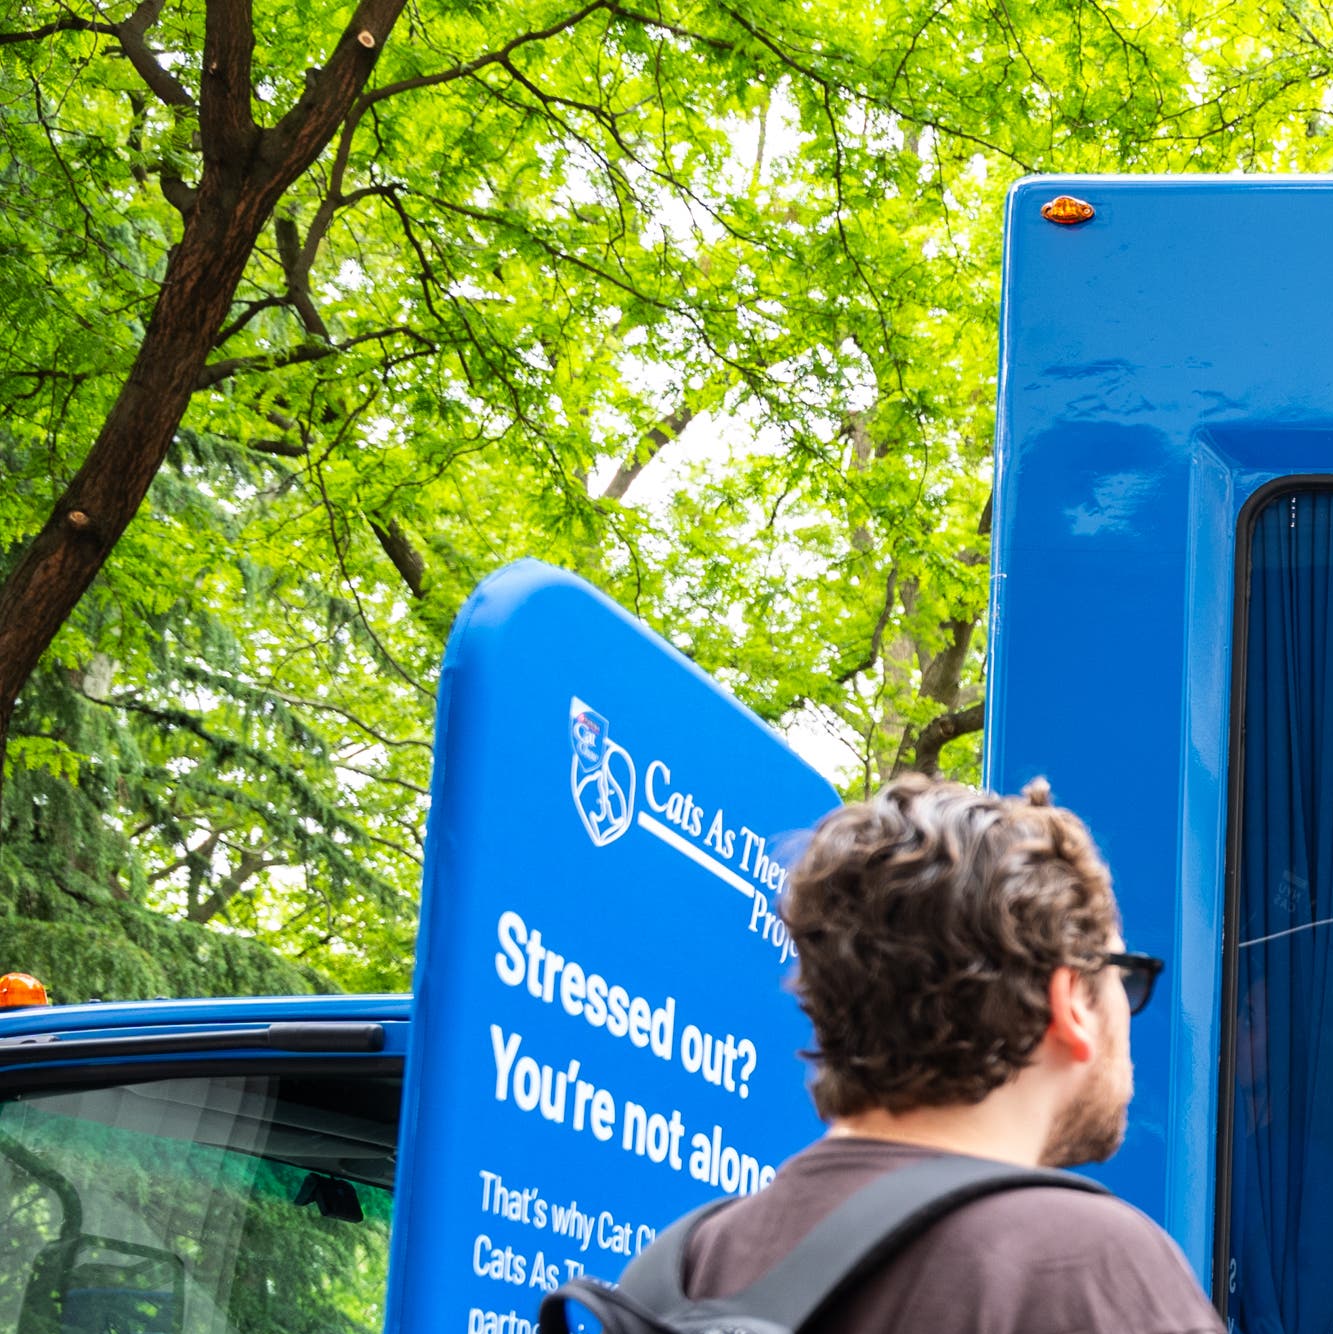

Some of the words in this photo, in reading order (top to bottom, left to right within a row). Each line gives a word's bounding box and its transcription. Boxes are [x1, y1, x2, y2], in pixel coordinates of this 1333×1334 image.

[645, 760, 704, 837] Cats
[703, 808, 736, 859] As
[739, 826, 788, 894] Ther
[495, 910, 676, 1061] Stressed
[680, 1024, 757, 1100] out?
[490, 1024, 616, 1141] You're
[622, 1101, 686, 1171] not
[689, 1125, 777, 1198] alone
[472, 1234, 527, 1286] Cats
[529, 1251, 560, 1294] As
[480, 1170, 548, 1230] That's
[551, 1201, 595, 1252] why
[597, 1211, 632, 1256] Cat
